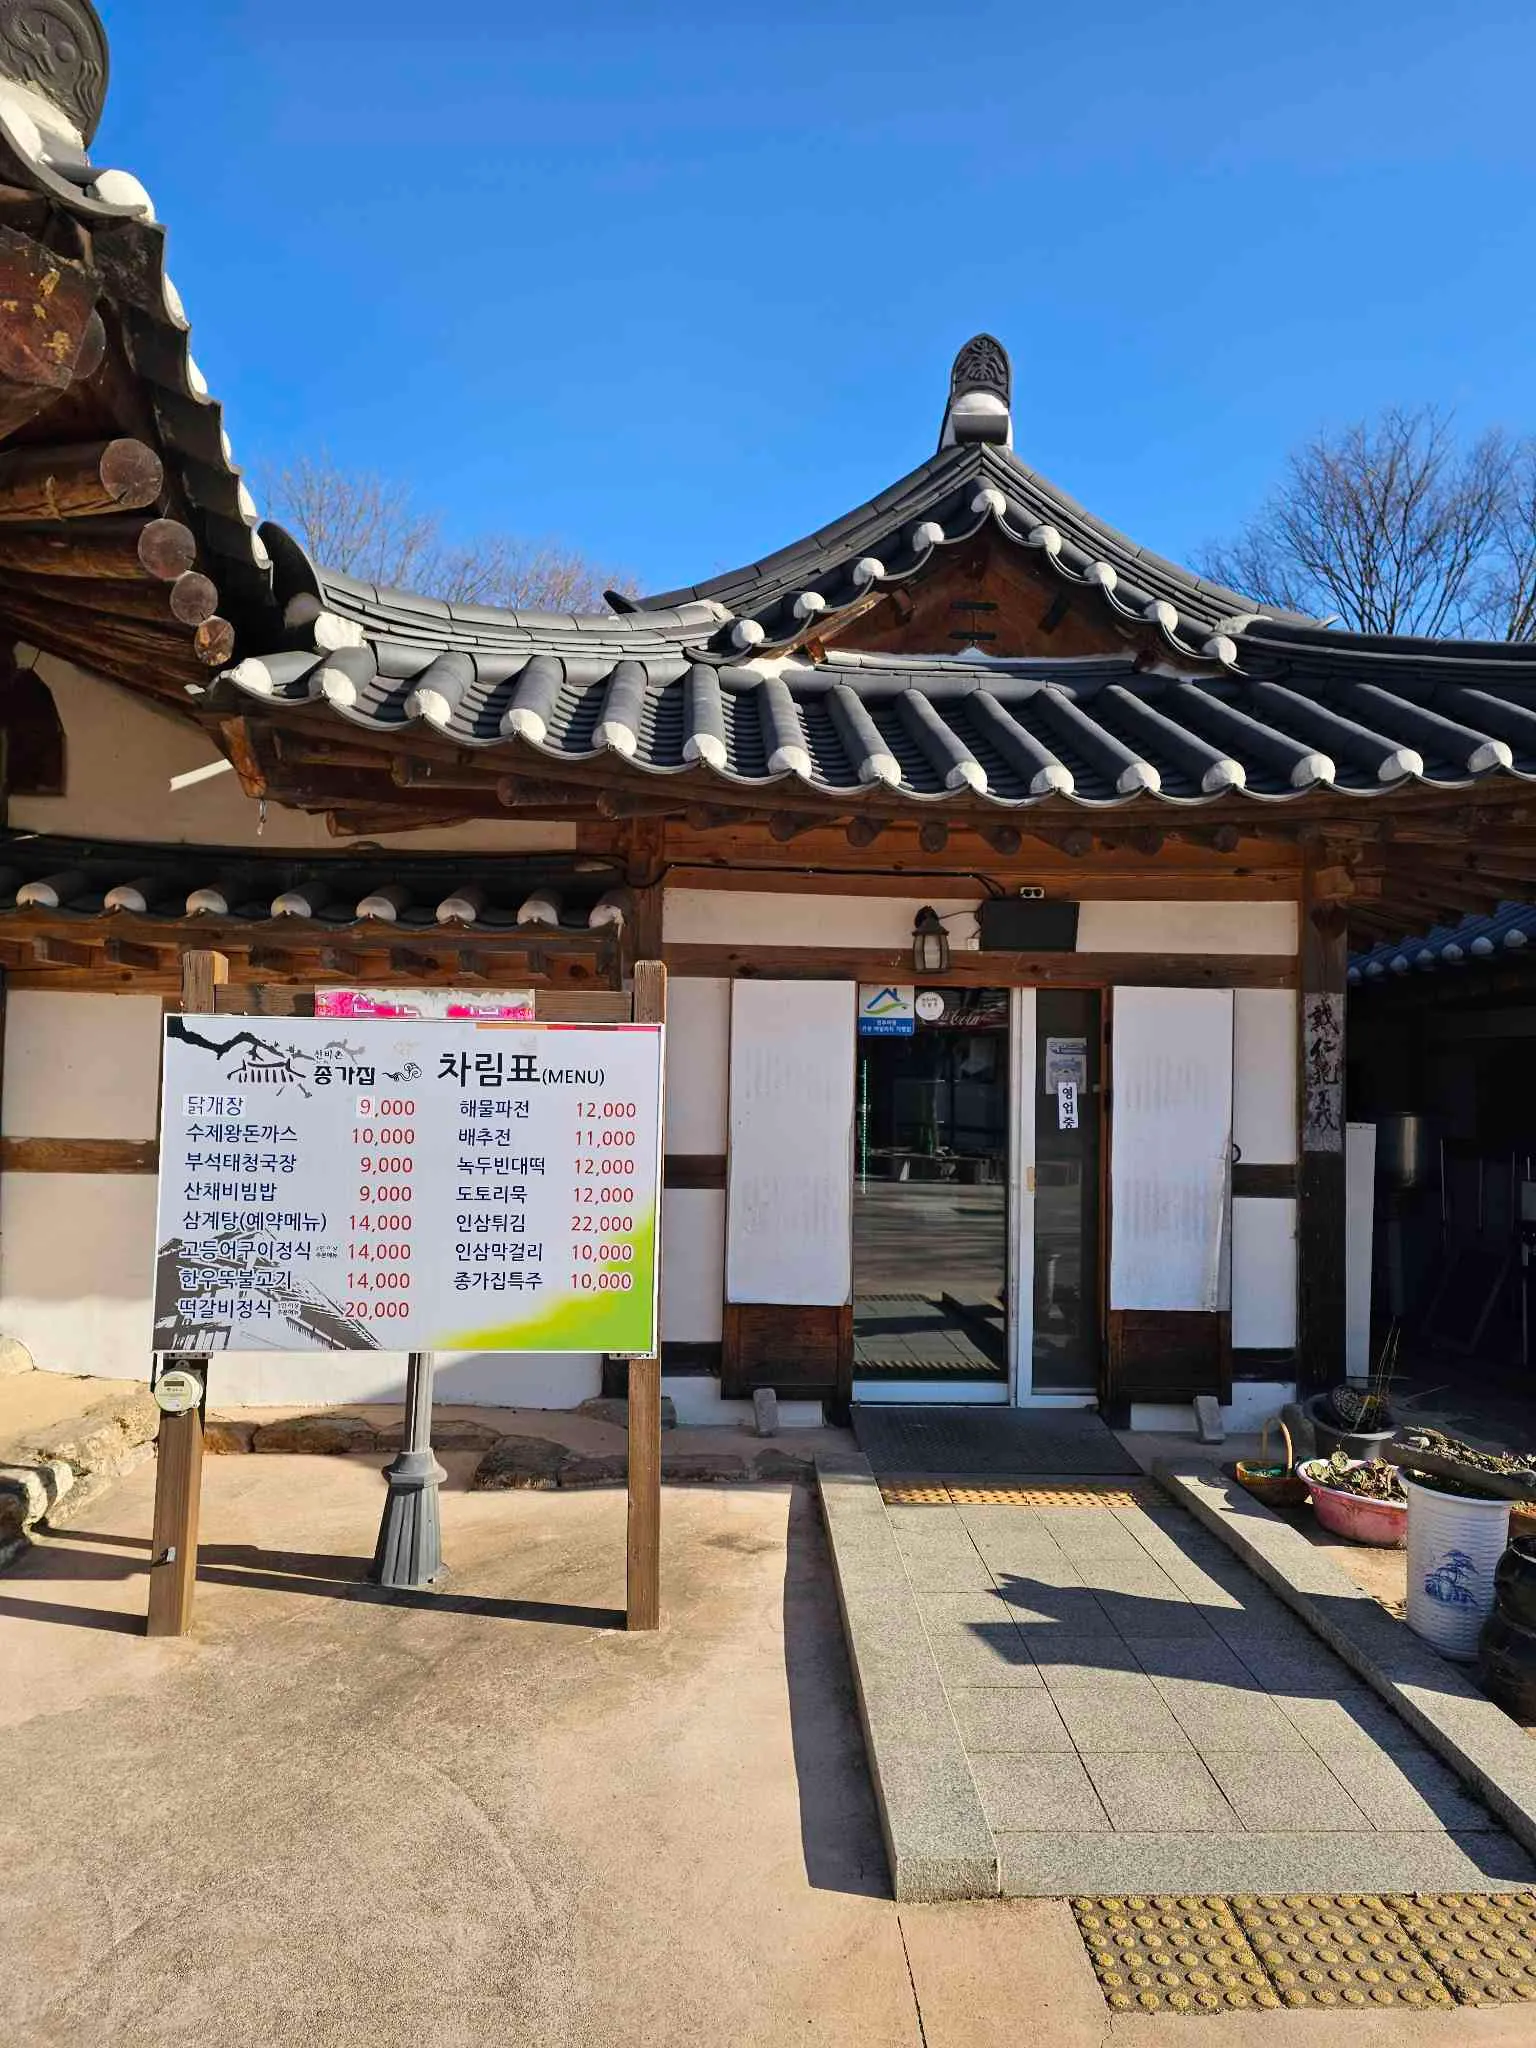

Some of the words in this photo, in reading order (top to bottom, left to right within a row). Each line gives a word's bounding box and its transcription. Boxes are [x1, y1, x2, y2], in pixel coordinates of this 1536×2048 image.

[313, 1065, 376, 1086] 종가집
[187, 1096, 244, 1116] 닭개장
[360, 1100, 416, 1117] 9,000
[459, 1099, 530, 1119] 해물파전
[577, 1103, 636, 1119] 12,000
[1062, 1086, 1075, 1129] 영업중
[185, 1123, 298, 1144] 수제왕돈까스
[352, 1128, 415, 1147] 10,000
[458, 1128, 511, 1147] 배추전
[575, 1131, 636, 1148] 11,000
[184, 1152, 297, 1174] 부석태청국장
[360, 1158, 413, 1175] 9,000
[456, 1156, 545, 1176] 녹두빈대떡
[574, 1159, 634, 1177] 12,000
[183, 1181, 278, 1202] 산채비빔밥
[359, 1186, 413, 1204] 9,000
[455, 1185, 528, 1205] 도토리묵
[574, 1187, 634, 1205] 12,000
[183, 1211, 327, 1232] 삼계탕(예약메뉴)
[350, 1215, 412, 1233] 14,000
[456, 1213, 526, 1233] 인삼튀김
[571, 1215, 633, 1233] 22,000
[347, 1244, 411, 1263] 14,000
[455, 1242, 543, 1262] 인삼막걸리
[572, 1244, 632, 1262] 10,000
[180, 1269, 292, 1290] 한우뚝불고기
[346, 1273, 410, 1291] 14,000
[453, 1271, 543, 1291] 종가집특주
[572, 1274, 632, 1292] 10,000
[179, 1298, 272, 1320] 떡갈비정식
[344, 1302, 409, 1321] 20,000
